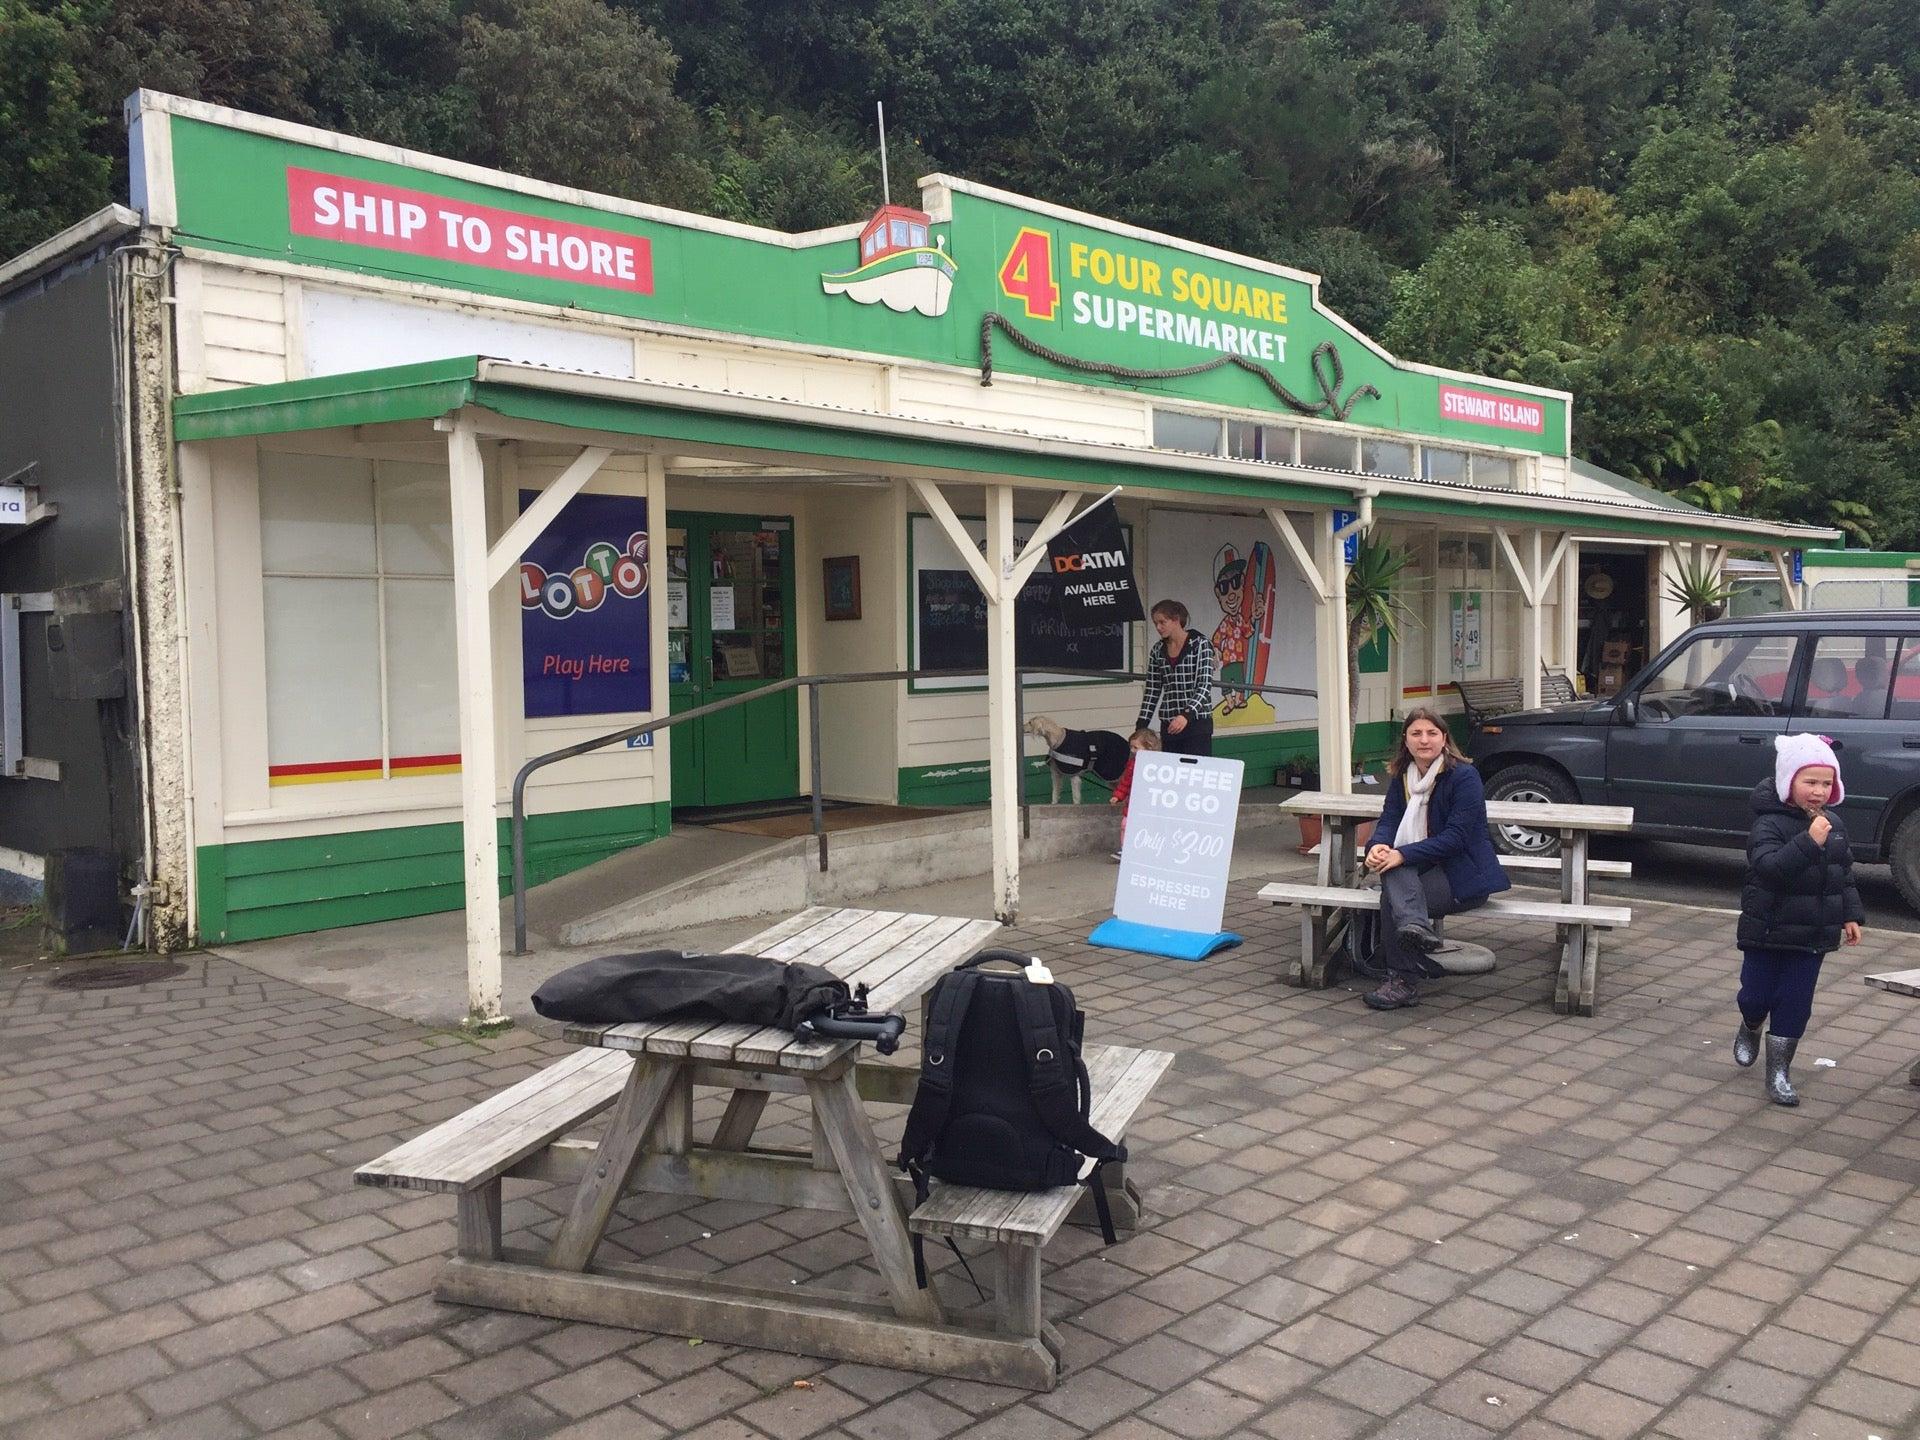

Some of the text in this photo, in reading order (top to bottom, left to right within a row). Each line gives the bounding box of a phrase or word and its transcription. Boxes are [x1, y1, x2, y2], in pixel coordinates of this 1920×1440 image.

[314, 186, 637, 281] SHIP TO SHORE
[999, 226, 1060, 321] 4
[1070, 242, 1288, 324] FOUR SQUARE
[1073, 291, 1287, 363] SUPERMARKET
[1444, 392, 1539, 426] STEWART ISLAND
[521, 549, 642, 609] LOTTO
[1064, 579, 1130, 596] AVAILABLE
[1082, 594, 1117, 607] HERE
[544, 654, 631, 680] Play Here
[632, 732, 649, 746] 20
[1142, 763, 1235, 792] COFFEE
[1148, 787, 1220, 814] TO GO
[1133, 828, 1166, 856] Only
[1130, 874, 1211, 899] ESPRESSED
[1148, 893, 1187, 911] HERE
